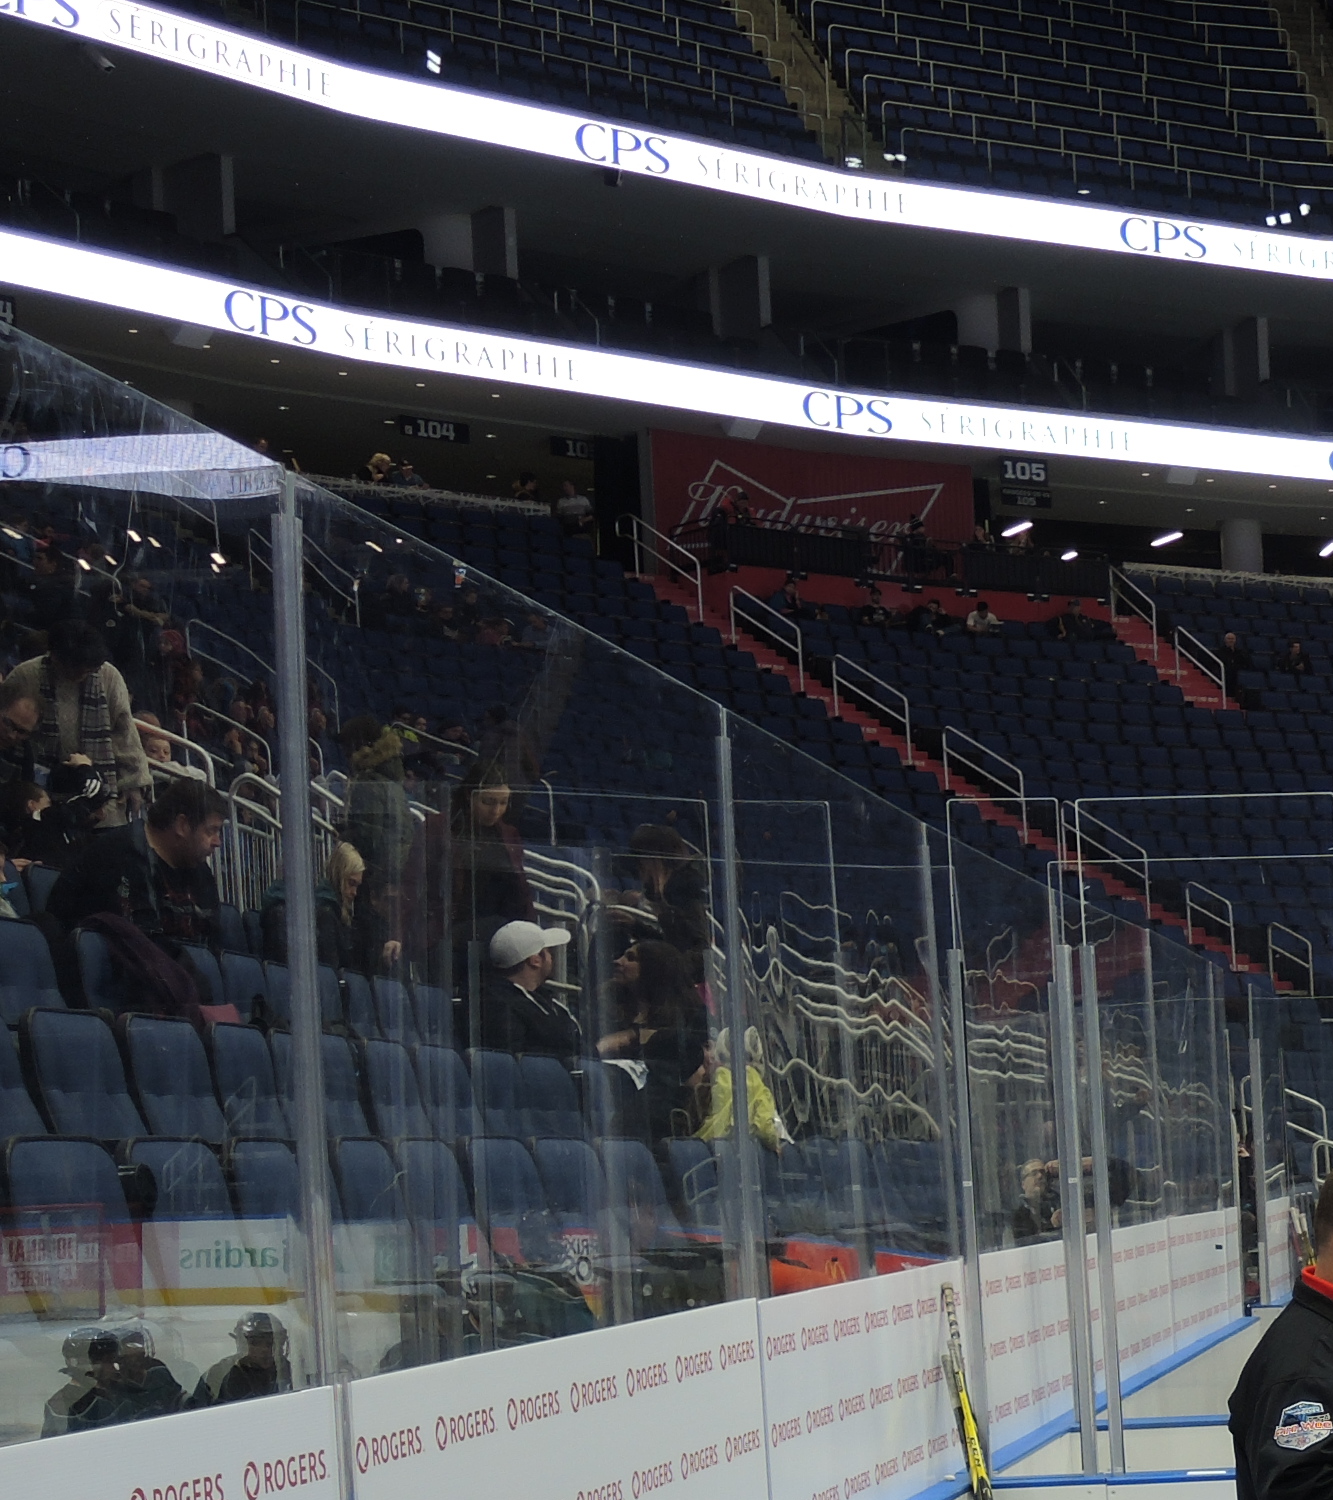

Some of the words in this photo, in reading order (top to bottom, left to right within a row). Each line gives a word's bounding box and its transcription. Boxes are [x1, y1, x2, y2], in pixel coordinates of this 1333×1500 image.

[109, 6, 332, 98] SÉRIGRAPHIE
[574, 122, 671, 175] CPS
[1119, 217, 1207, 259] CPS
[224, 289, 318, 345] CPS
[417, 420, 455, 441] 104
[803, 391, 893, 435] CPS
[1003, 460, 1047, 483] 105
[372, 1425, 423, 1468] ROGERS
[450, 1406, 496, 1446] ROGERS
[521, 1389, 561, 1424] ROGERS
[581, 1375, 618, 1407] ROGERS
[636, 1361, 668, 1391] ROGERS
